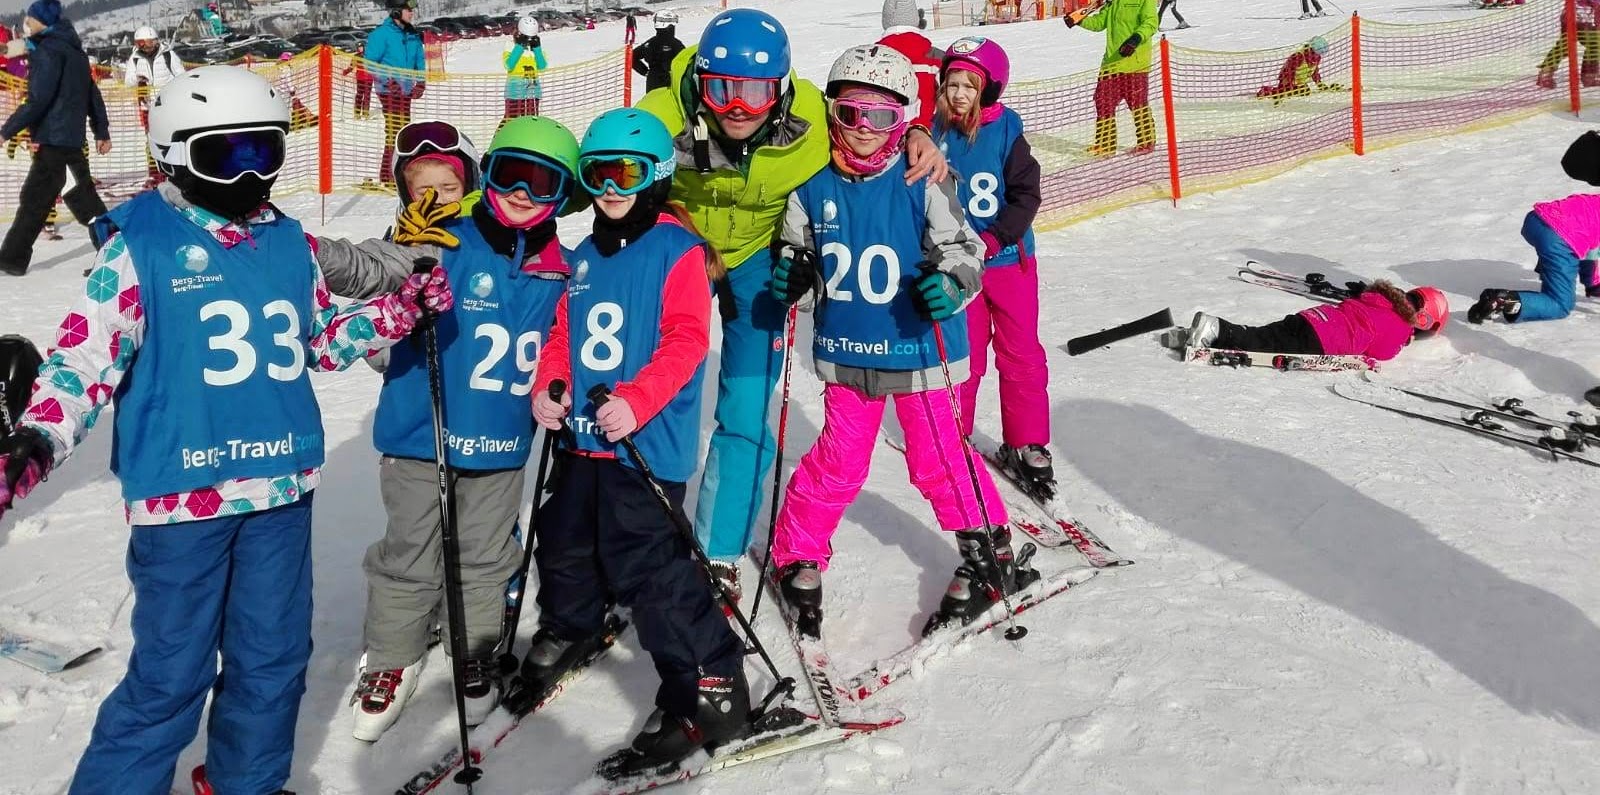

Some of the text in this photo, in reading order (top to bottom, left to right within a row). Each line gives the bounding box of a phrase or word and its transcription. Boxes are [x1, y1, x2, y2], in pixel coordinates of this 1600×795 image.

[171, 274, 223, 287] Berg-Travel
[821, 241, 901, 305] 20
[199, 299, 305, 386] 33
[469, 322, 541, 396] 29
[580, 301, 624, 371] 8
[814, 329, 930, 355] erg-Travel.com
